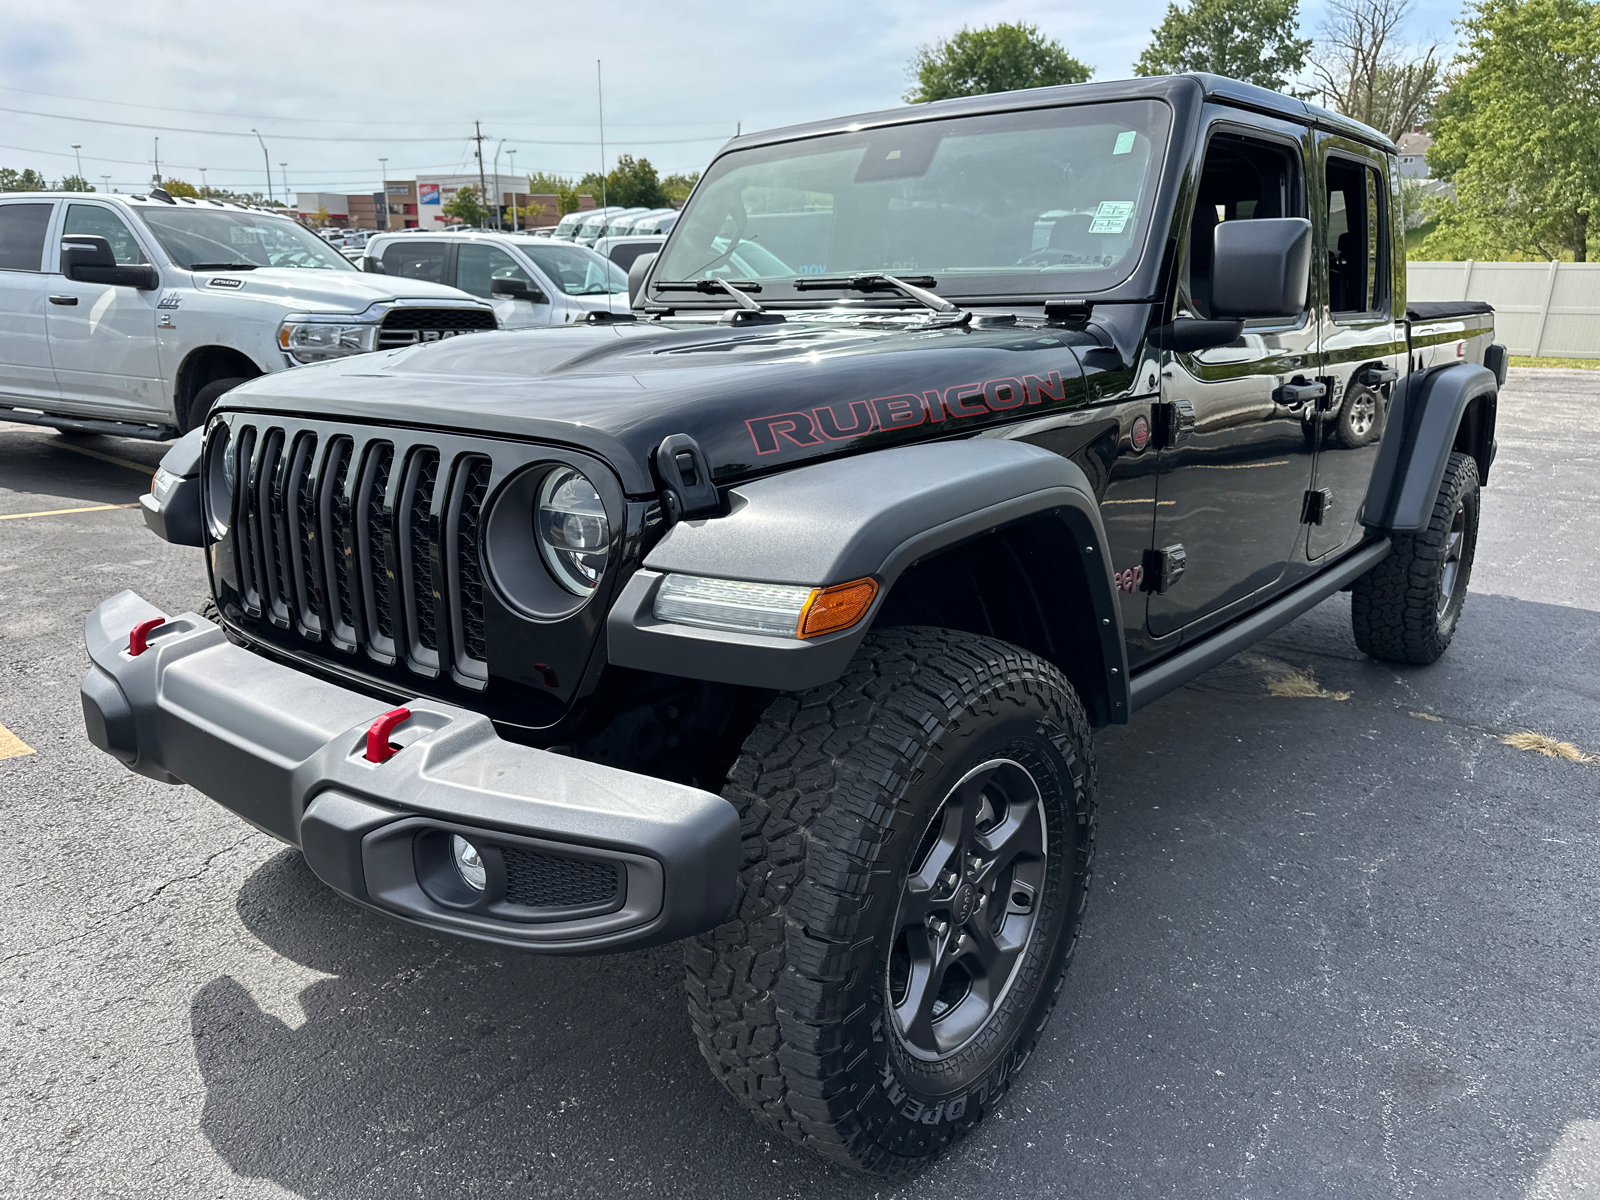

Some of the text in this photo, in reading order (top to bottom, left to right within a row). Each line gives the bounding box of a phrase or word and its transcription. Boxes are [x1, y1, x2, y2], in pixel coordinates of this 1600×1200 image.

[160, 297, 182, 305] CITY
[422, 330, 474, 342] RA
[744, 370, 1067, 456] RUBICON
[1113, 564, 1144, 594] eep
